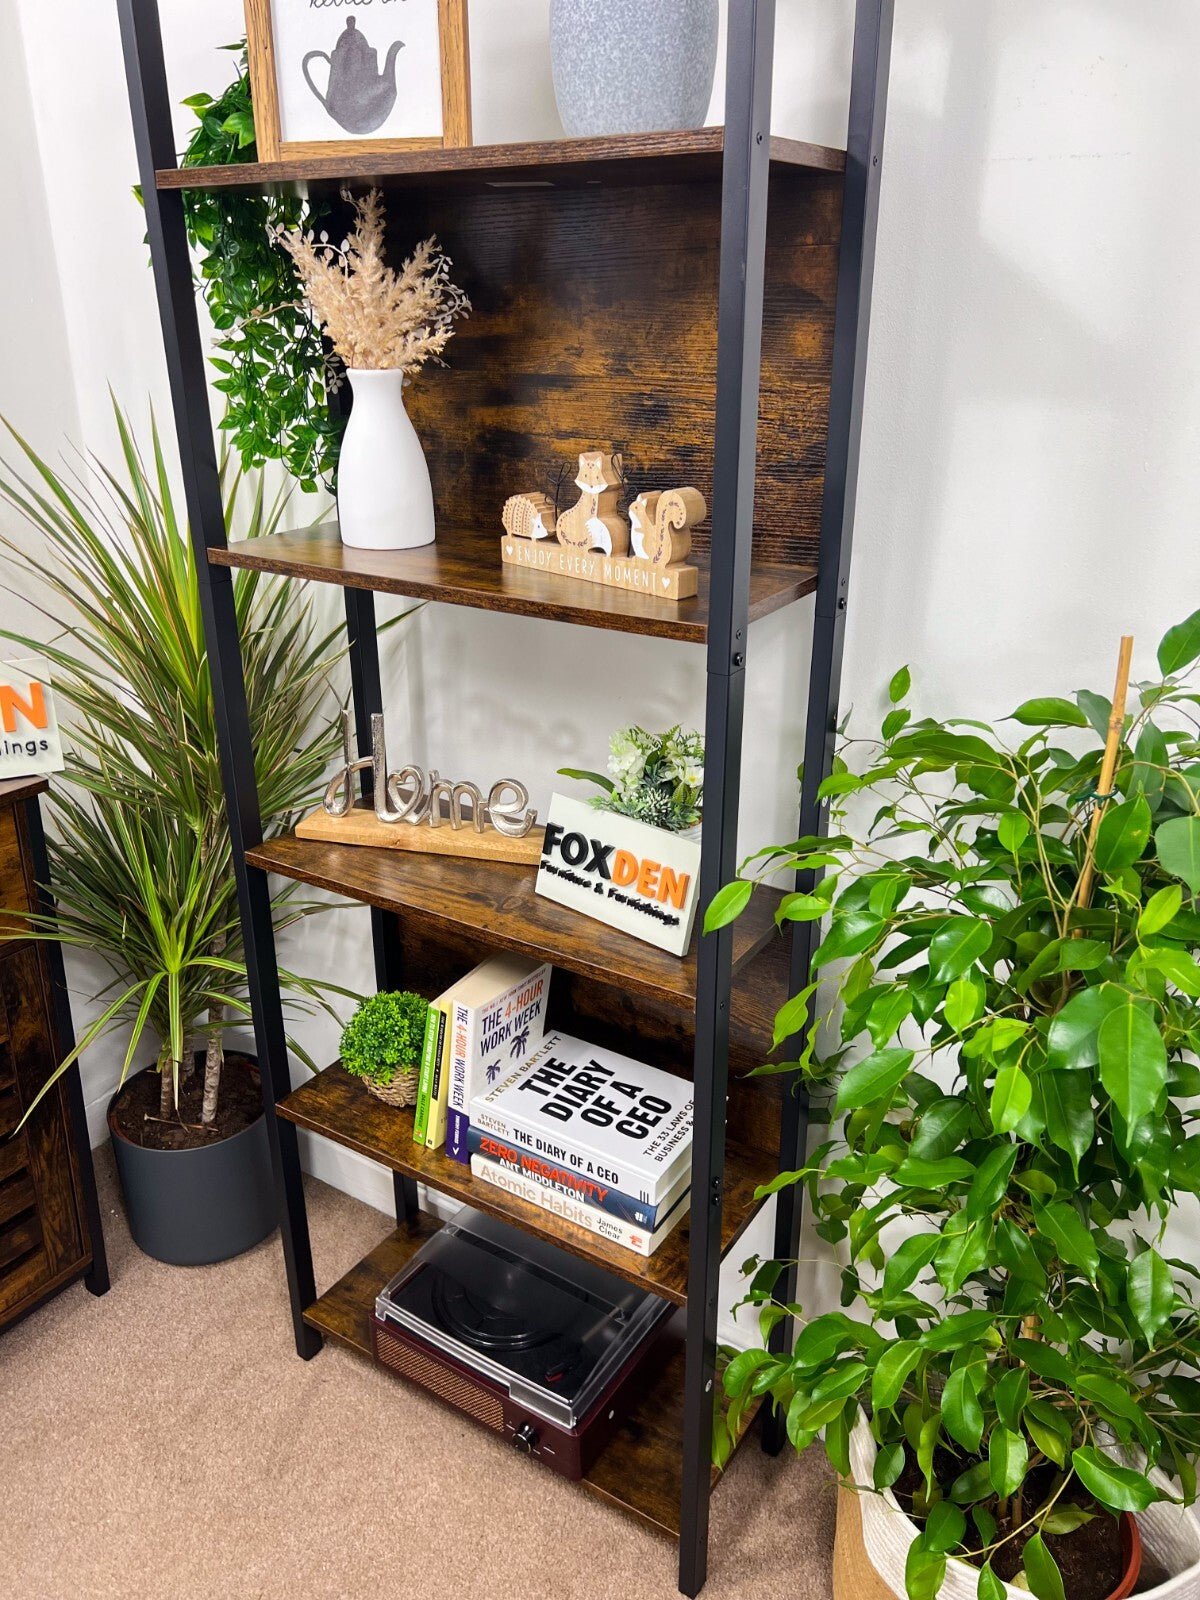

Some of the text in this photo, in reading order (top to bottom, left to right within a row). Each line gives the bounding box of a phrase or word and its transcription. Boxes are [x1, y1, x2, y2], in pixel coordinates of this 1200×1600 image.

[518, 545, 658, 592] ENJOY EVERY MOMENT
[0, 740, 49, 756] ings
[323, 709, 537, 838] home
[542, 822, 690, 909] FOXDEN
[594, 882, 604, 894] &
[457, 1006, 469, 1025] THE
[480, 1020, 512, 1057] WORK
[514, 998, 542, 1032] WEEK
[482, 1007, 502, 1035] THE
[504, 979, 544, 1018] 4-HOUR
[455, 1024, 468, 1058] 4-HOUR
[453, 1058, 466, 1084] WORK
[485, 1035, 561, 1102] STEVEN BARTLETT
[518, 1057, 578, 1096] THE
[539, 1059, 615, 1122] DIARY
[452, 1084, 464, 1109] WEEK
[581, 1081, 644, 1127] OF A
[615, 1095, 672, 1139] CEO
[477, 1118, 510, 1136] BARTLETT
[480, 1114, 506, 1129] STEVEN
[643, 1141, 662, 1156] THE
[657, 1131, 670, 1141] 33
[666, 1110, 688, 1131] LAWS
[513, 1128, 619, 1184] THE DIARY OF A CEO
[654, 1126, 689, 1162] BUSINESS
[480, 1136, 609, 1202] ZERO NEGATIVITY
[500, 1158, 586, 1203] ANT MIDDLETON
[481, 1165, 593, 1227] Atomic Habits
[597, 1217, 623, 1234] James
[598, 1226, 621, 1240] Clear
